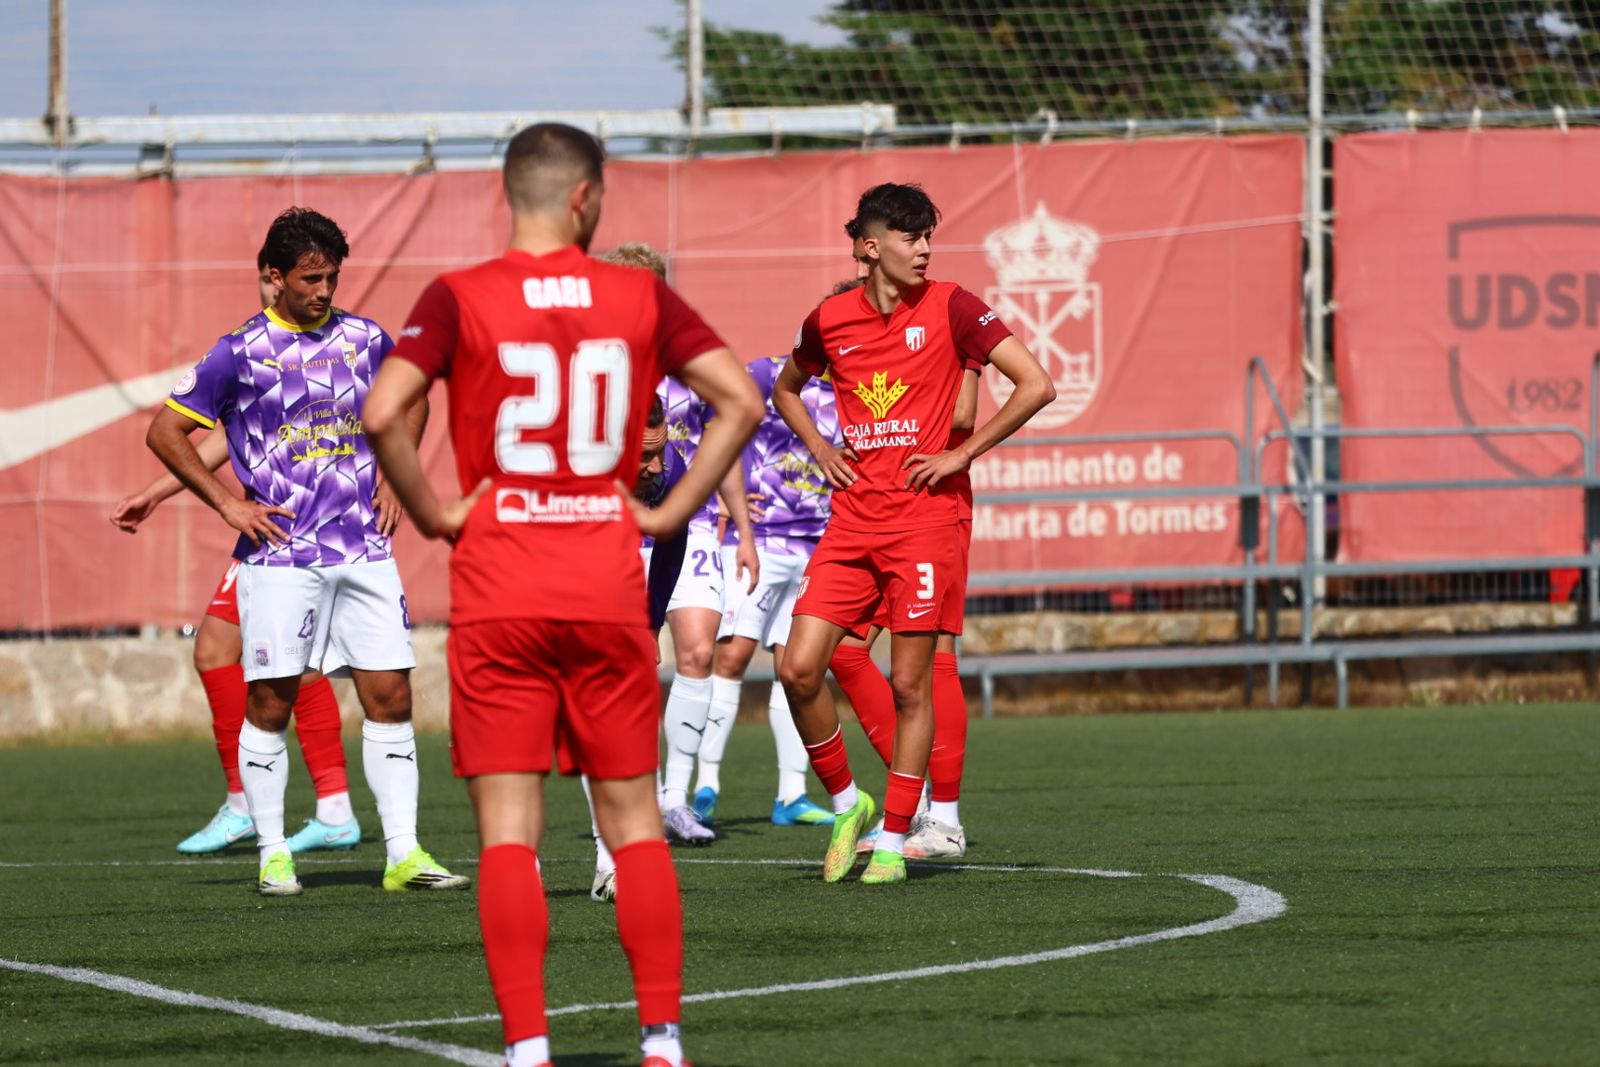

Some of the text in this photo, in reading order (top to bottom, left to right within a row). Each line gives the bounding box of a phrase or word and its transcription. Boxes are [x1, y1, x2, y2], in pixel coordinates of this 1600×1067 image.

[522, 276, 593, 308] GABI
[495, 338, 632, 476] 20
[1506, 377, 1583, 413] 1982
[843, 419, 920, 439] CAJA RURAL
[853, 435, 918, 451] SALAMANCA
[1143, 444, 1183, 482] de
[1067, 501, 1108, 538] de
[1113, 501, 1228, 536] Tormes
[916, 562, 935, 600] 3
